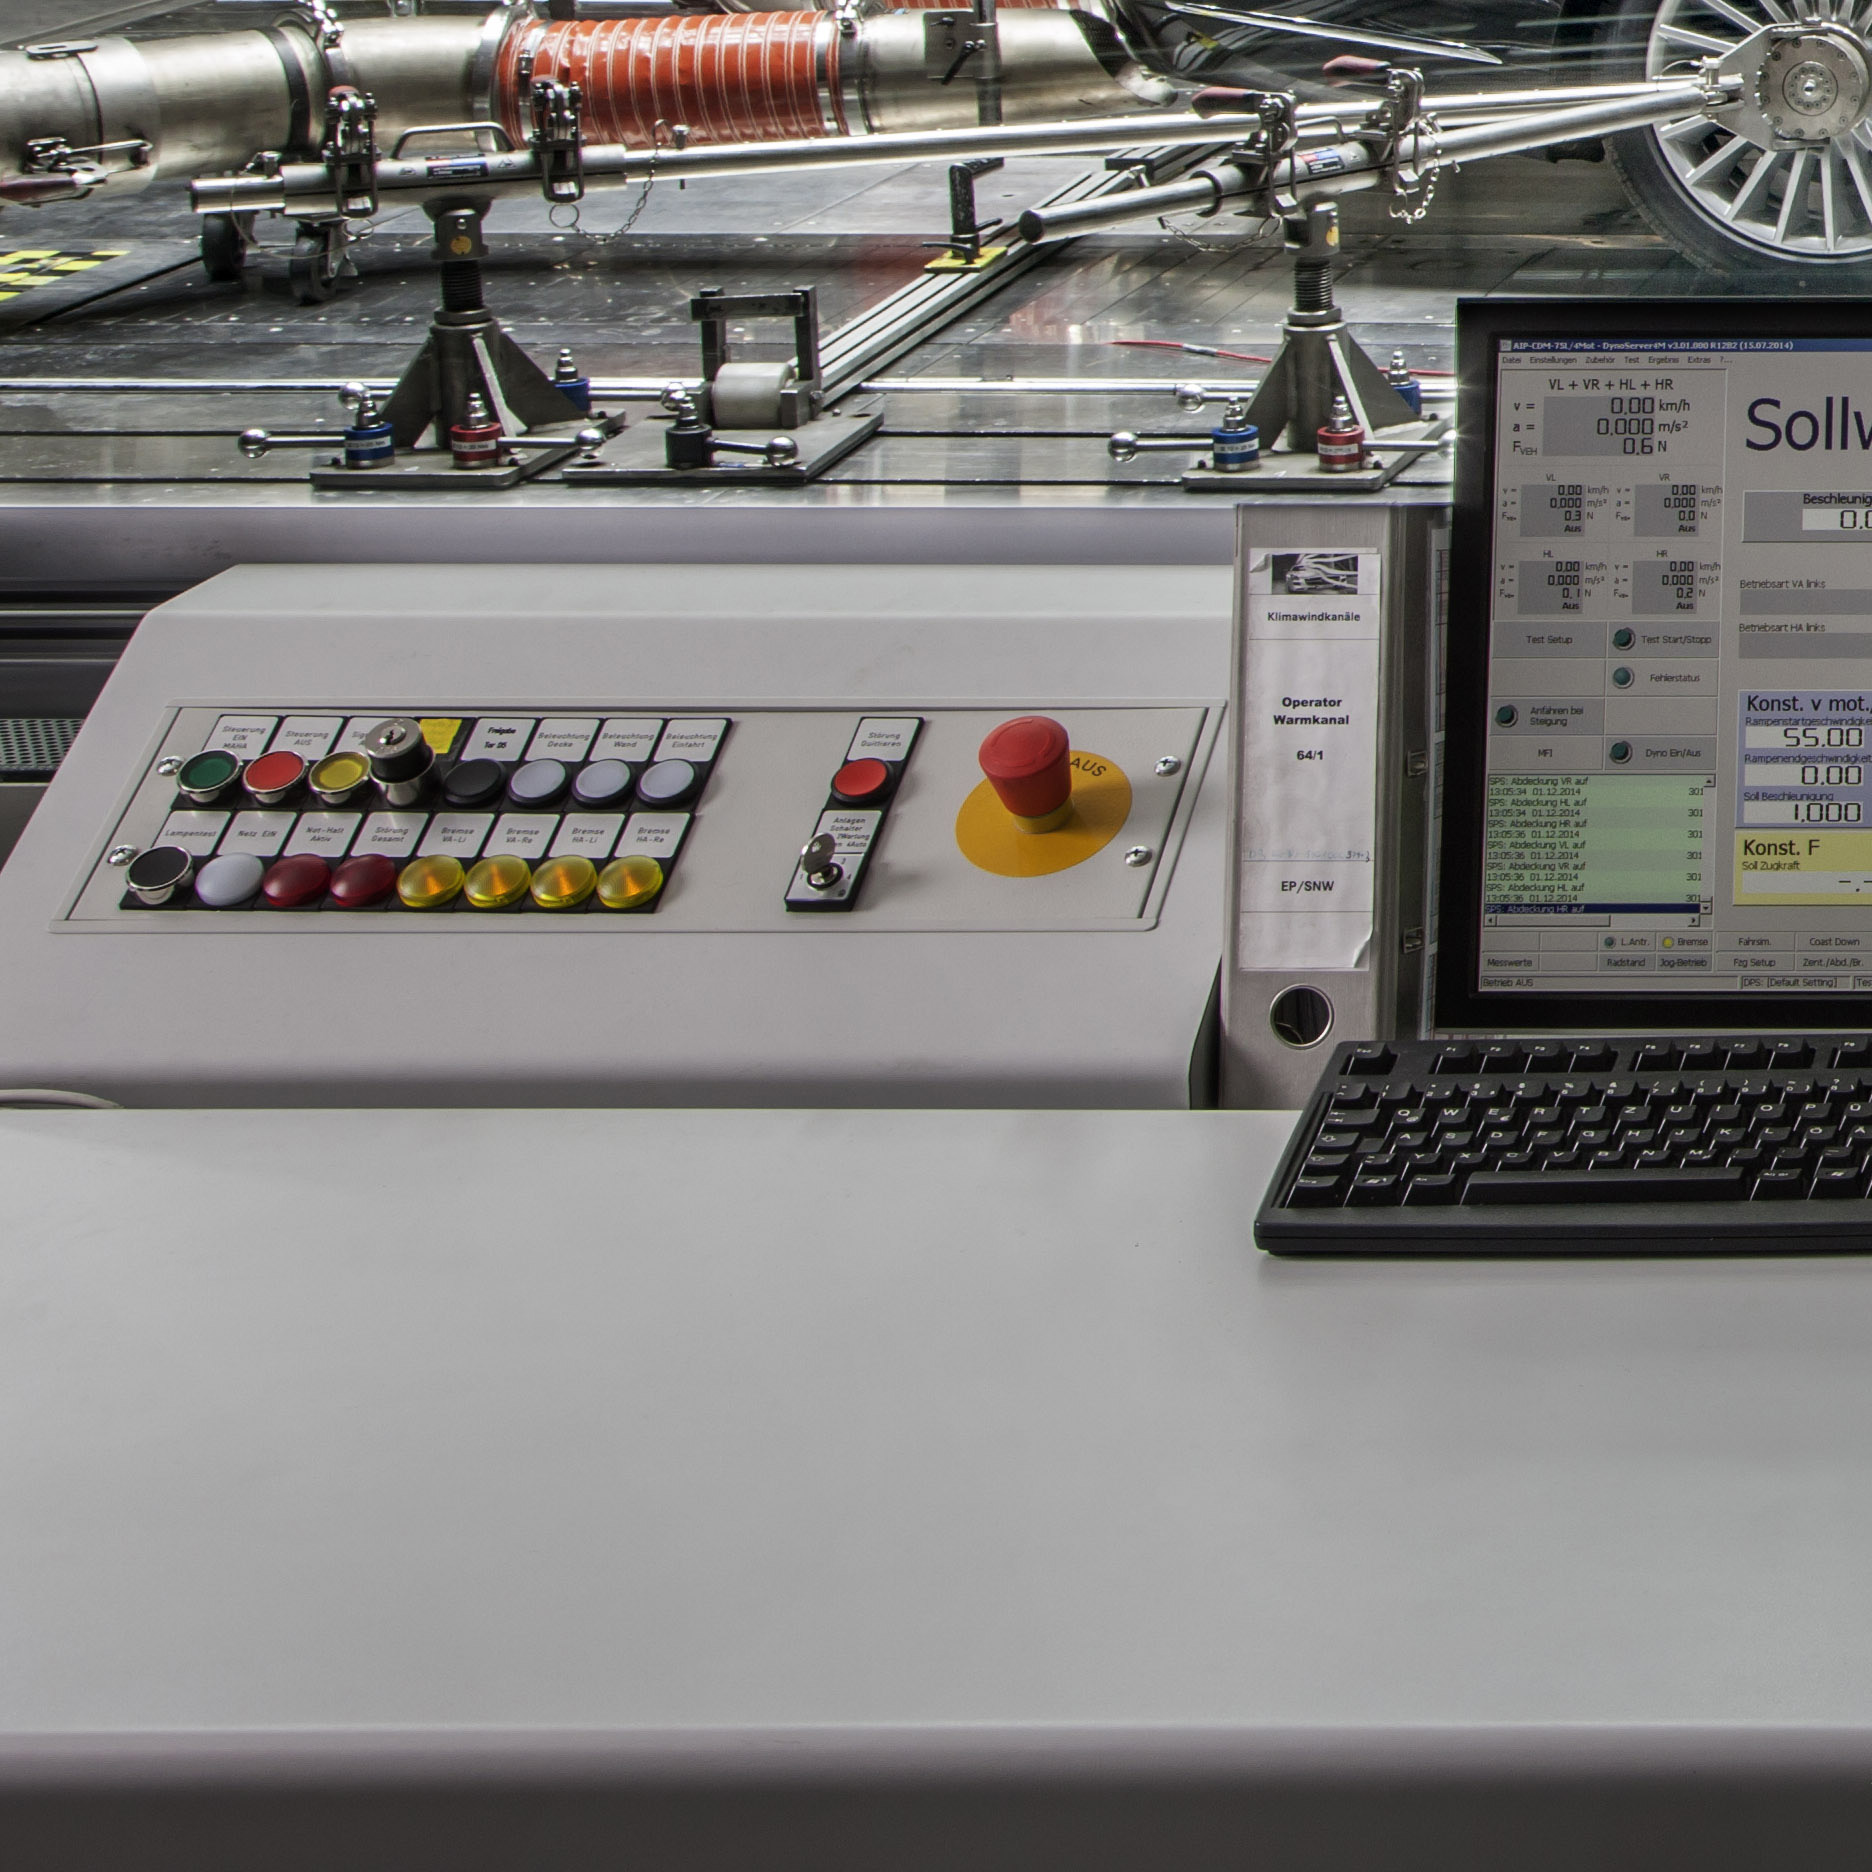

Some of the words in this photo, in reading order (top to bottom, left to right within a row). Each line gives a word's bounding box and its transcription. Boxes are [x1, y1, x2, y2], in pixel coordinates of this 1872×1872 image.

[1740, 341, 1794, 350] (15.07.2014)
[1530, 357, 1576, 365] Einstellungen
[1648, 357, 1679, 365] Ergebnis
[1549, 379, 1564, 390] VL
[1583, 379, 1599, 390] VR
[1619, 379, 1636, 390] HL
[1655, 379, 1674, 390] HR
[1659, 400, 1690, 412] km/h
[1658, 441, 1667, 451] N
[1267, 612, 1361, 622] Klimawindkanäle
[1282, 697, 1342, 709] Operator
[1747, 695, 1803, 712] Konst.
[1811, 699, 1822, 711] v
[1273, 715, 1350, 725] Warmkanal
[222, 726, 266, 734] Steuerung
[488, 727, 516, 735] Freigabe
[285, 731, 328, 739] Steuerung
[538, 733, 590, 742] Beleuchtung
[602, 733, 654, 742] Beleuchtung
[666, 733, 718, 742] Beleuchtung
[867, 731, 901, 741] Störung
[484, 741, 496, 749] Tor
[1297, 750, 1323, 760] 64/1
[1070, 757, 1106, 777] AUS
[833, 817, 865, 825] Anlagen
[165, 830, 217, 838] Lampentest
[305, 826, 344, 834] Not-Halt
[375, 826, 409, 835] Störung
[441, 827, 474, 835] Bremse
[506, 827, 540, 836] Bremse
[571, 827, 604, 836] Bremse
[638, 827, 670, 835] Bremse
[371, 835, 405, 843] Gesamt
[442, 835, 466, 843] VA-Li
[506, 836, 532, 844] VA-Re
[572, 836, 598, 844] HA-Li
[637, 835, 664, 843] HA-Re
[1743, 840, 1800, 855] Konst.
[1808, 840, 1820, 855] F
[1281, 881, 1334, 894] EP/SNW
